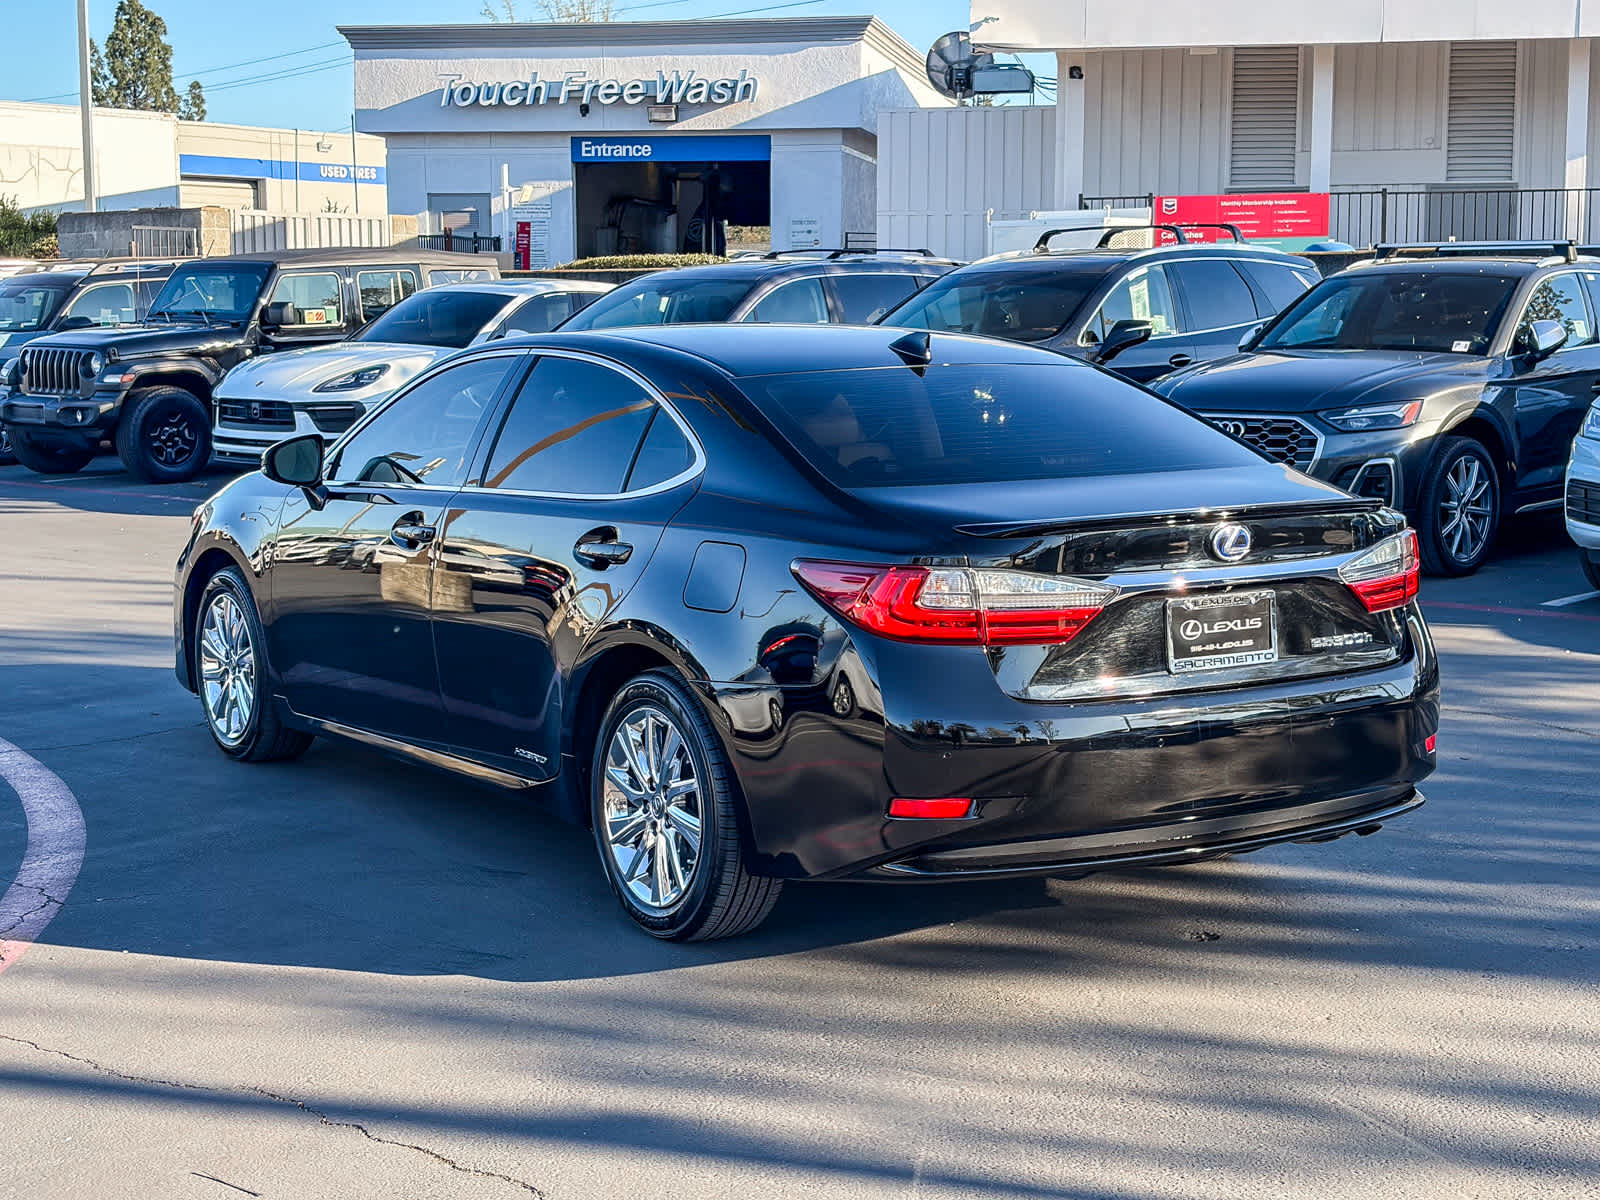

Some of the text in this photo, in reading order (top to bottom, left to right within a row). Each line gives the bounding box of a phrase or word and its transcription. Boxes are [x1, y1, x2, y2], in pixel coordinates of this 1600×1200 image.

[438, 69, 759, 107] Touch Free Wash
[581, 141, 652, 157] Entrance
[320, 165, 377, 180] USED TIRES
[1204, 617, 1262, 633] LEXUS
[1174, 652, 1275, 670] SACRAMENTO
